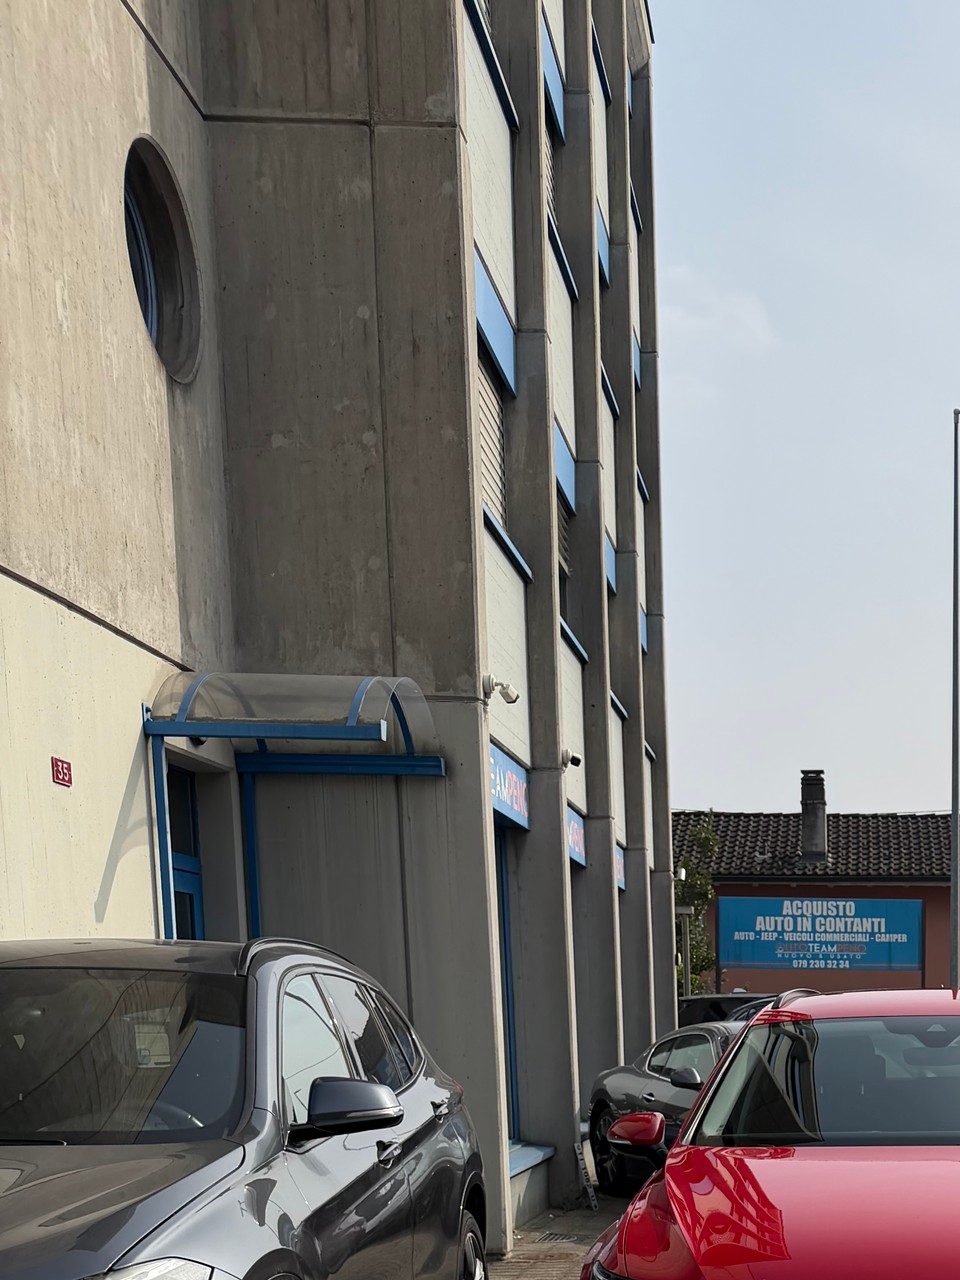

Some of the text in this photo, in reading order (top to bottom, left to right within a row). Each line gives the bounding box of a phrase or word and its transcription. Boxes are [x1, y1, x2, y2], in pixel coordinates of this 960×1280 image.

[57, 761, 69, 781] 35
[782, 900, 856, 917] ACQUISTO
[755, 916, 886, 933] AUTO IN CONTANTI
[734, 932, 754, 941] AUTO
[761, 932, 778, 941] JEEP
[783, 932, 814, 941] VEICOLI
[815, 933, 869, 942] COMMERCIALI
[875, 933, 907, 943] CAMPER
[793, 960, 850, 969] 079 230 32 34
